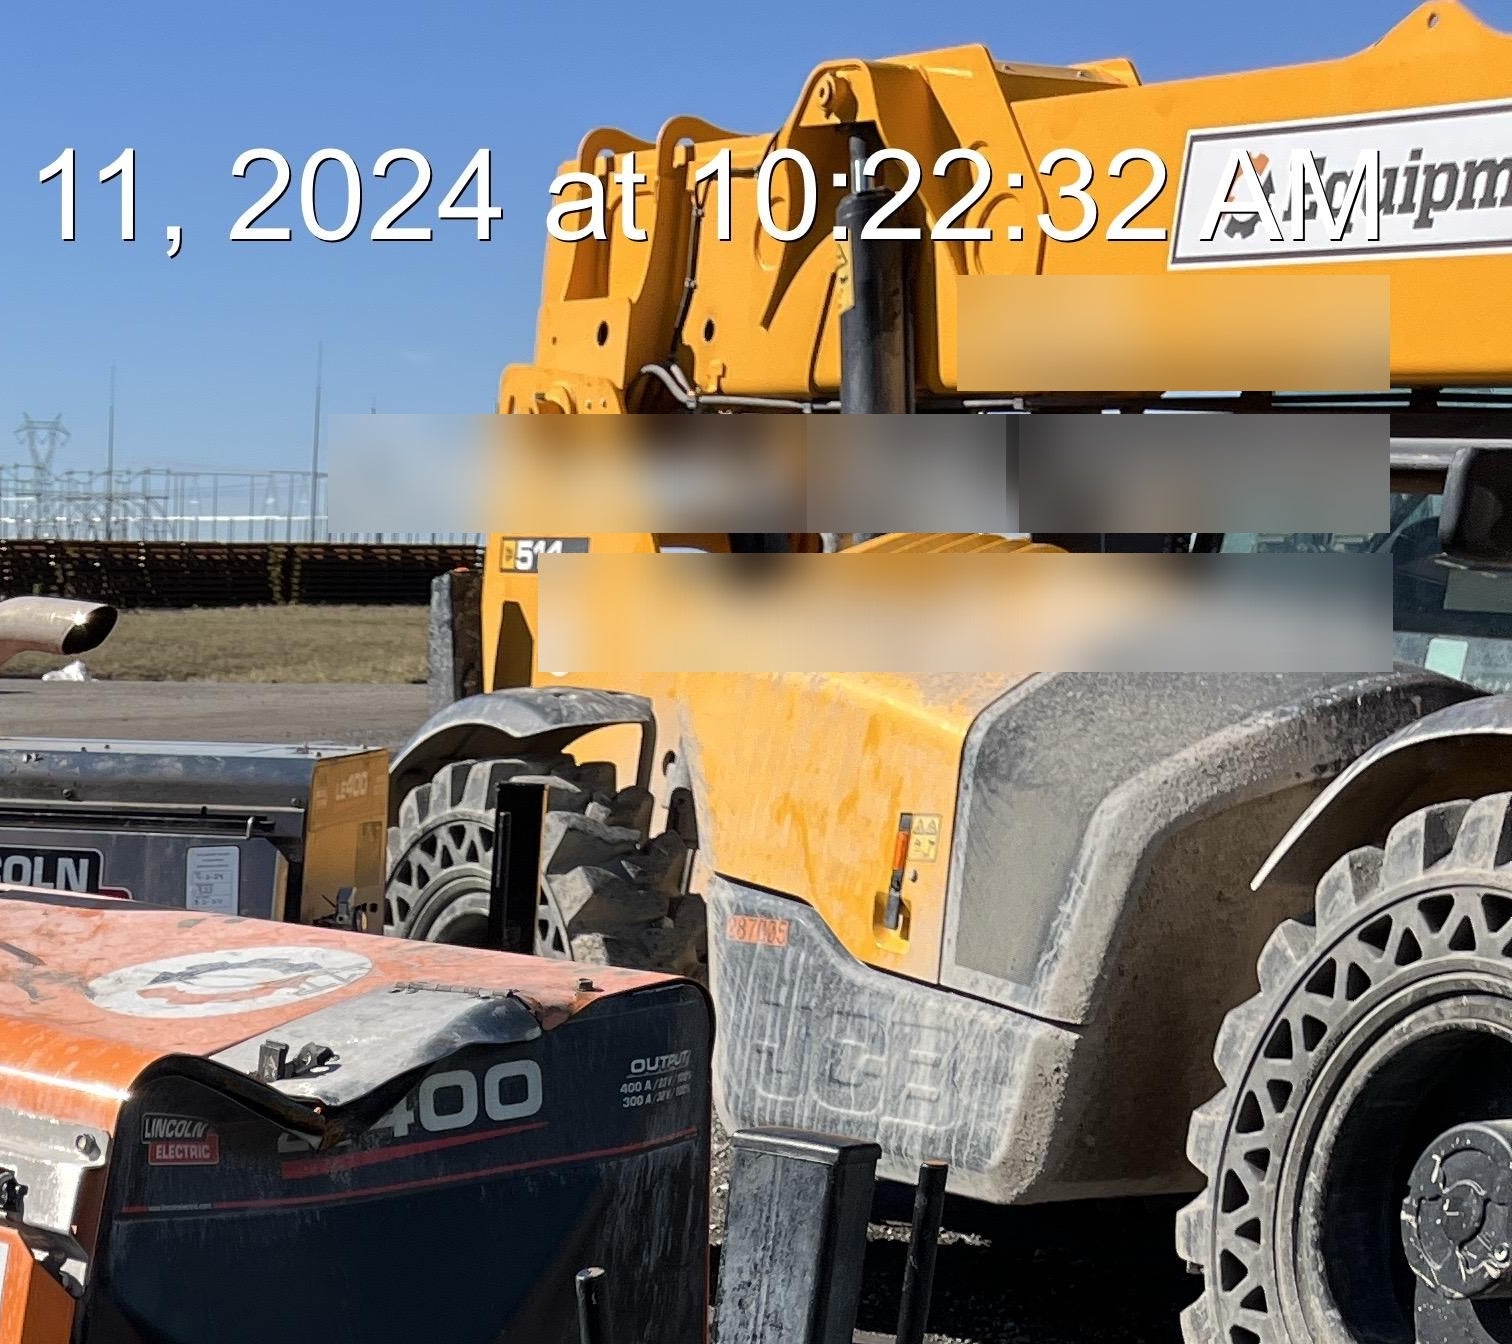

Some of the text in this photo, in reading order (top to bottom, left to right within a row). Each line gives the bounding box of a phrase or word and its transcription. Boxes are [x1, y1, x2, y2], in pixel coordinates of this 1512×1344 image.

[630, 1050, 691, 1073] OUTPUT
[620, 1081, 642, 1094] 400
[368, 1059, 544, 1138] 400
[622, 1095, 643, 1108] 300
[144, 1118, 209, 1139] LINCOLN
[156, 1144, 211, 1160] ELECTRIC
